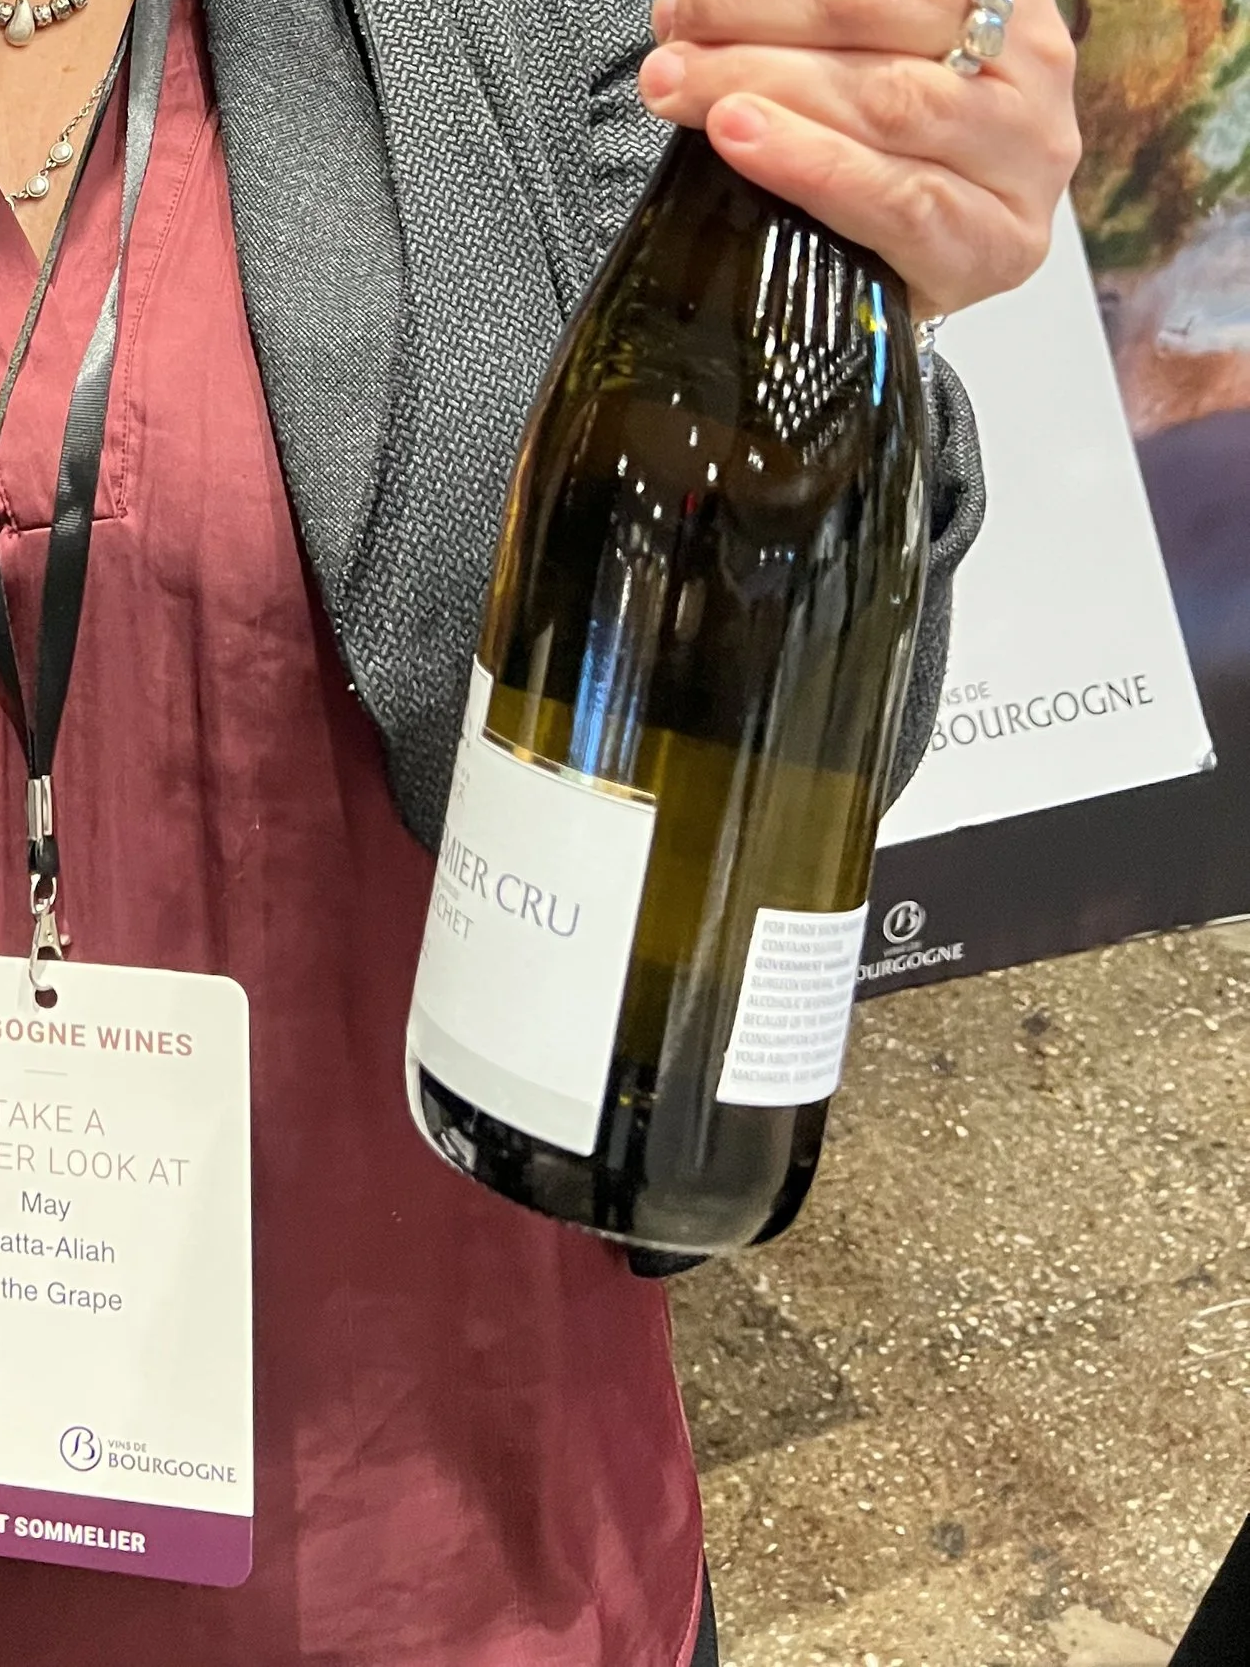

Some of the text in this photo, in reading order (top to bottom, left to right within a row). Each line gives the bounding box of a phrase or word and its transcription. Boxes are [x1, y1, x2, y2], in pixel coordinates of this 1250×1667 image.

[931, 674, 1154, 752] BOURGOGNE
[440, 821, 581, 938] MIER CRU
[856, 941, 965, 982] OURGOGNE
[97, 1025, 194, 1057] WINES
[84, 1108, 106, 1137] A
[49, 1147, 138, 1183] LOOK
[148, 1157, 191, 1187] AT
[21, 1190, 71, 1222] May
[1, 1276, 38, 1302] the
[47, 1281, 123, 1314] Grape
[107, 1438, 147, 1453] VINS DE
[107, 1452, 238, 1484] BOURGOGNE
[14, 1516, 146, 1554] SOMMELIER
